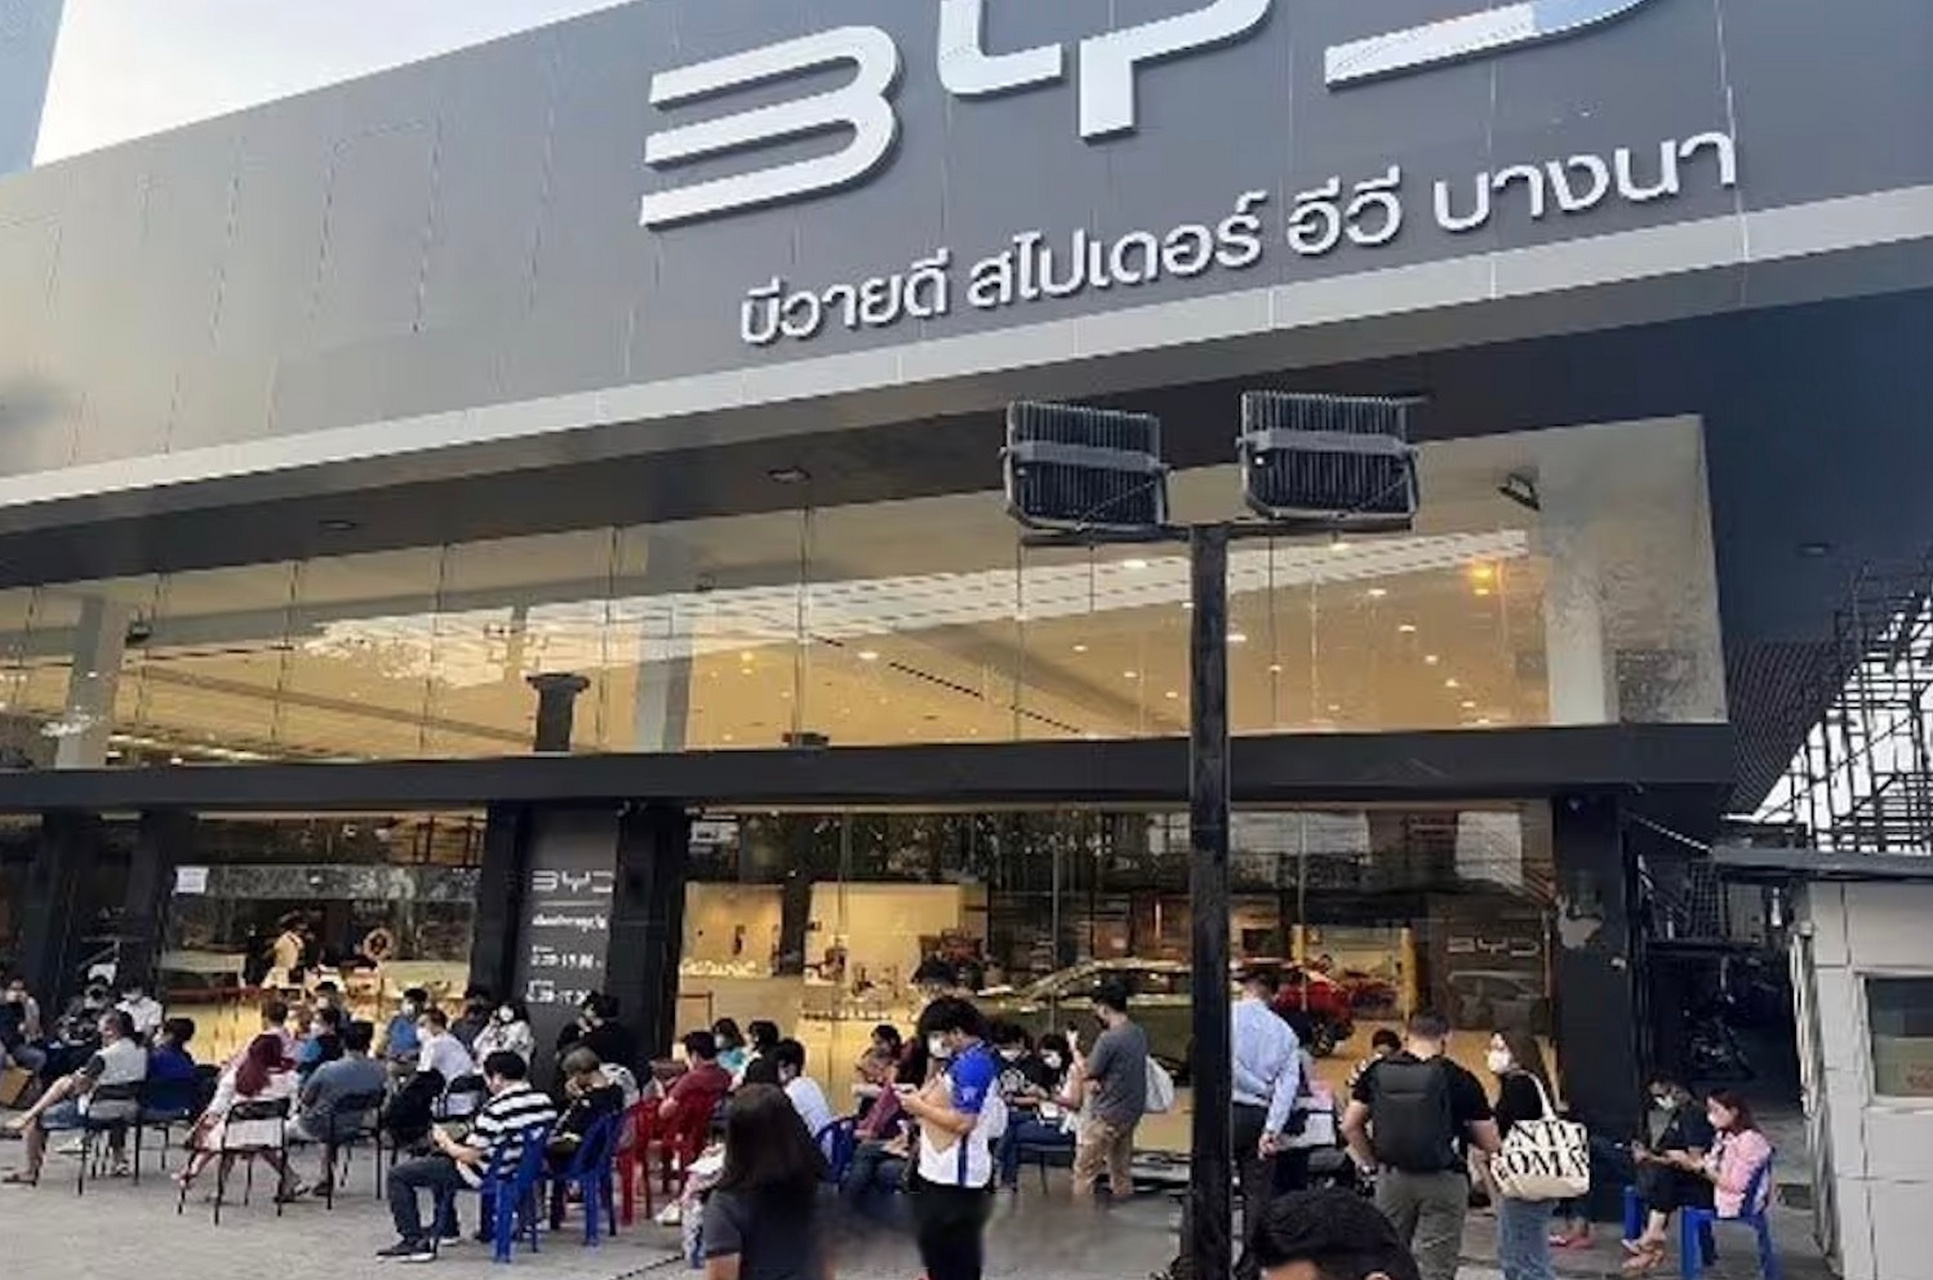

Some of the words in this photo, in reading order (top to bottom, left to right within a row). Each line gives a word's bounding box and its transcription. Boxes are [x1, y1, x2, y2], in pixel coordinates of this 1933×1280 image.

[741, 248, 949, 345] บีวายดี
[968, 189, 1267, 309] สไปเดอร์
[1288, 165, 1401, 255] อีวี
[1434, 131, 1736, 232] บางนา
[531, 869, 614, 893] BYD
[1447, 936, 1541, 957] BYD
